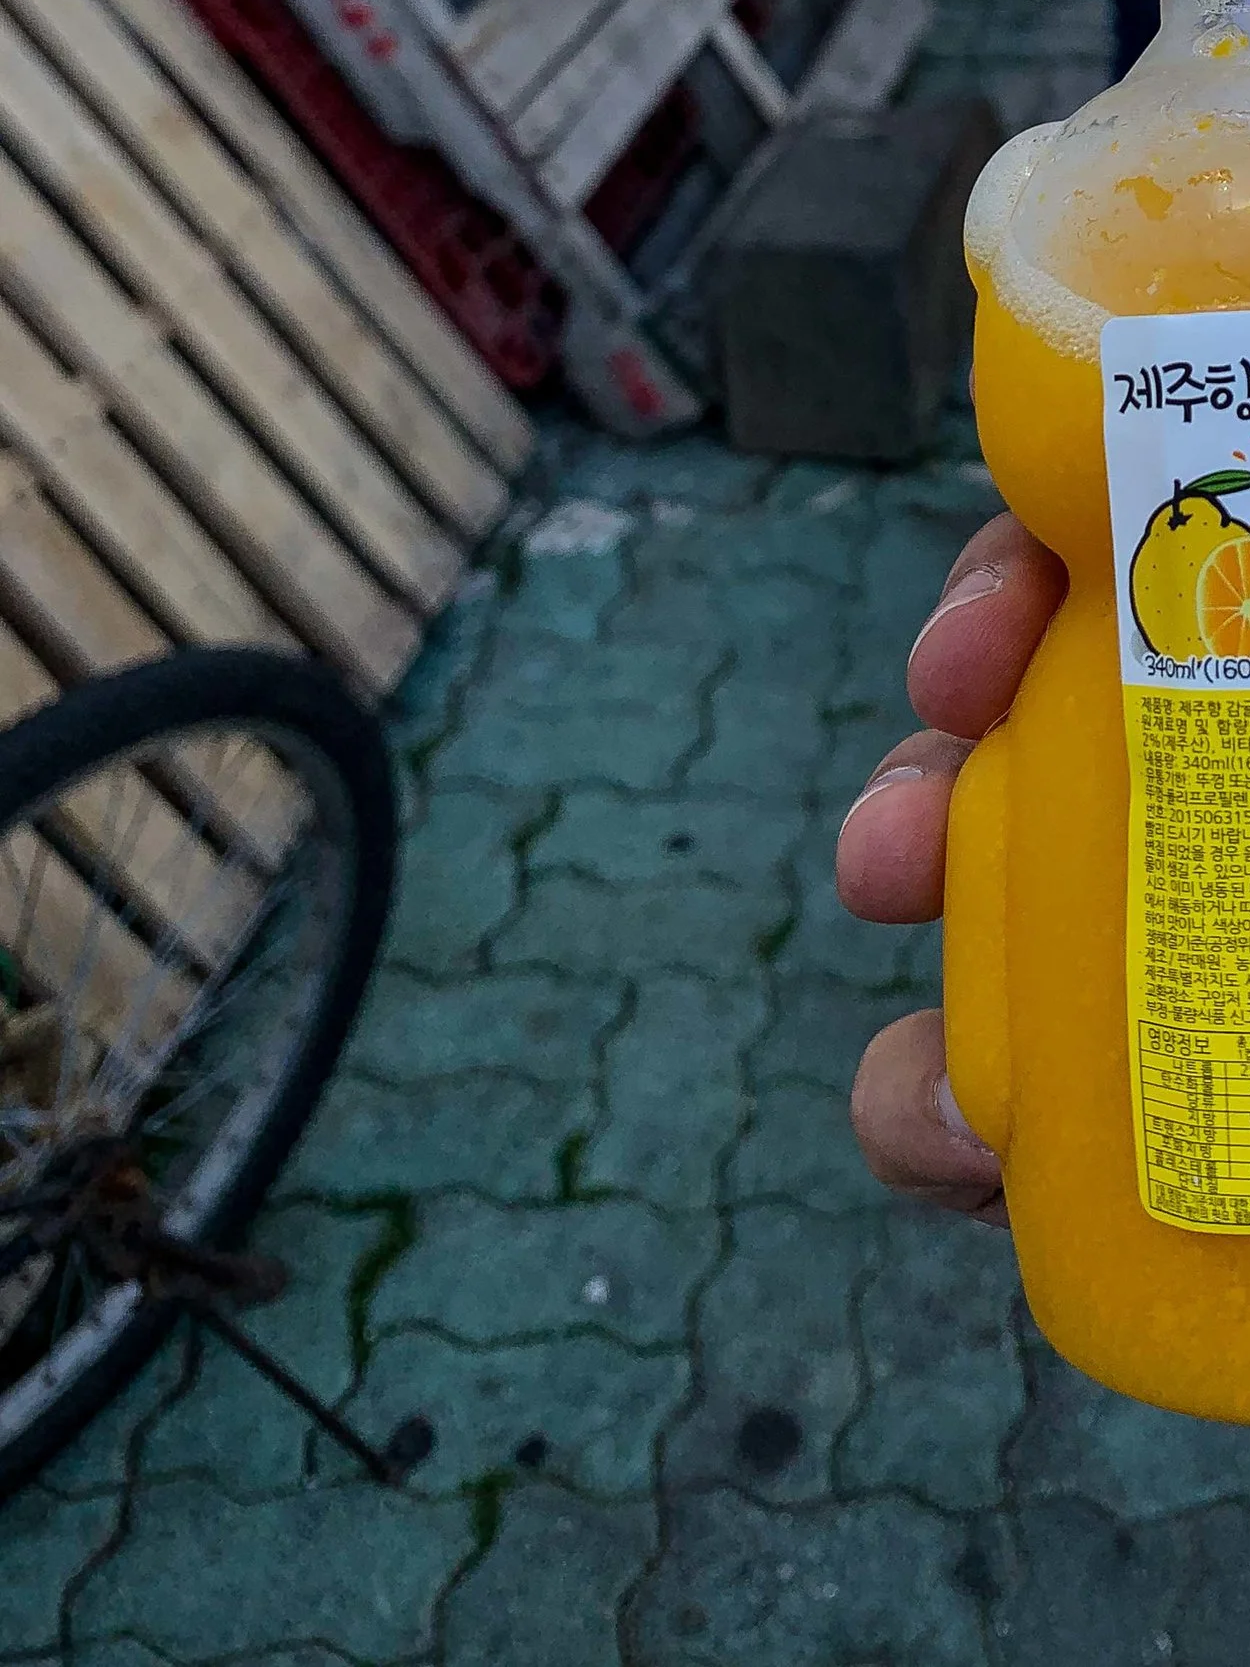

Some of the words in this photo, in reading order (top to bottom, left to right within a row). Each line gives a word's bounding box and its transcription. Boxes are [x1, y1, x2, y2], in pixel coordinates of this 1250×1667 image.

[1180, 699, 1222, 718] 제주향
[1195, 718, 1209, 735] 및
[1195, 771, 1226, 790] 뚜껑
[1167, 824, 1206, 844] 드시기
[1210, 845, 1240, 863] 경우
[1192, 863, 1208, 880] 수
[1200, 880, 1246, 900] 냉동된
[1167, 914, 1205, 934] 맛이나
[1197, 989, 1241, 1008] 구입처
[1147, 1027, 1212, 1057] 영양정보
